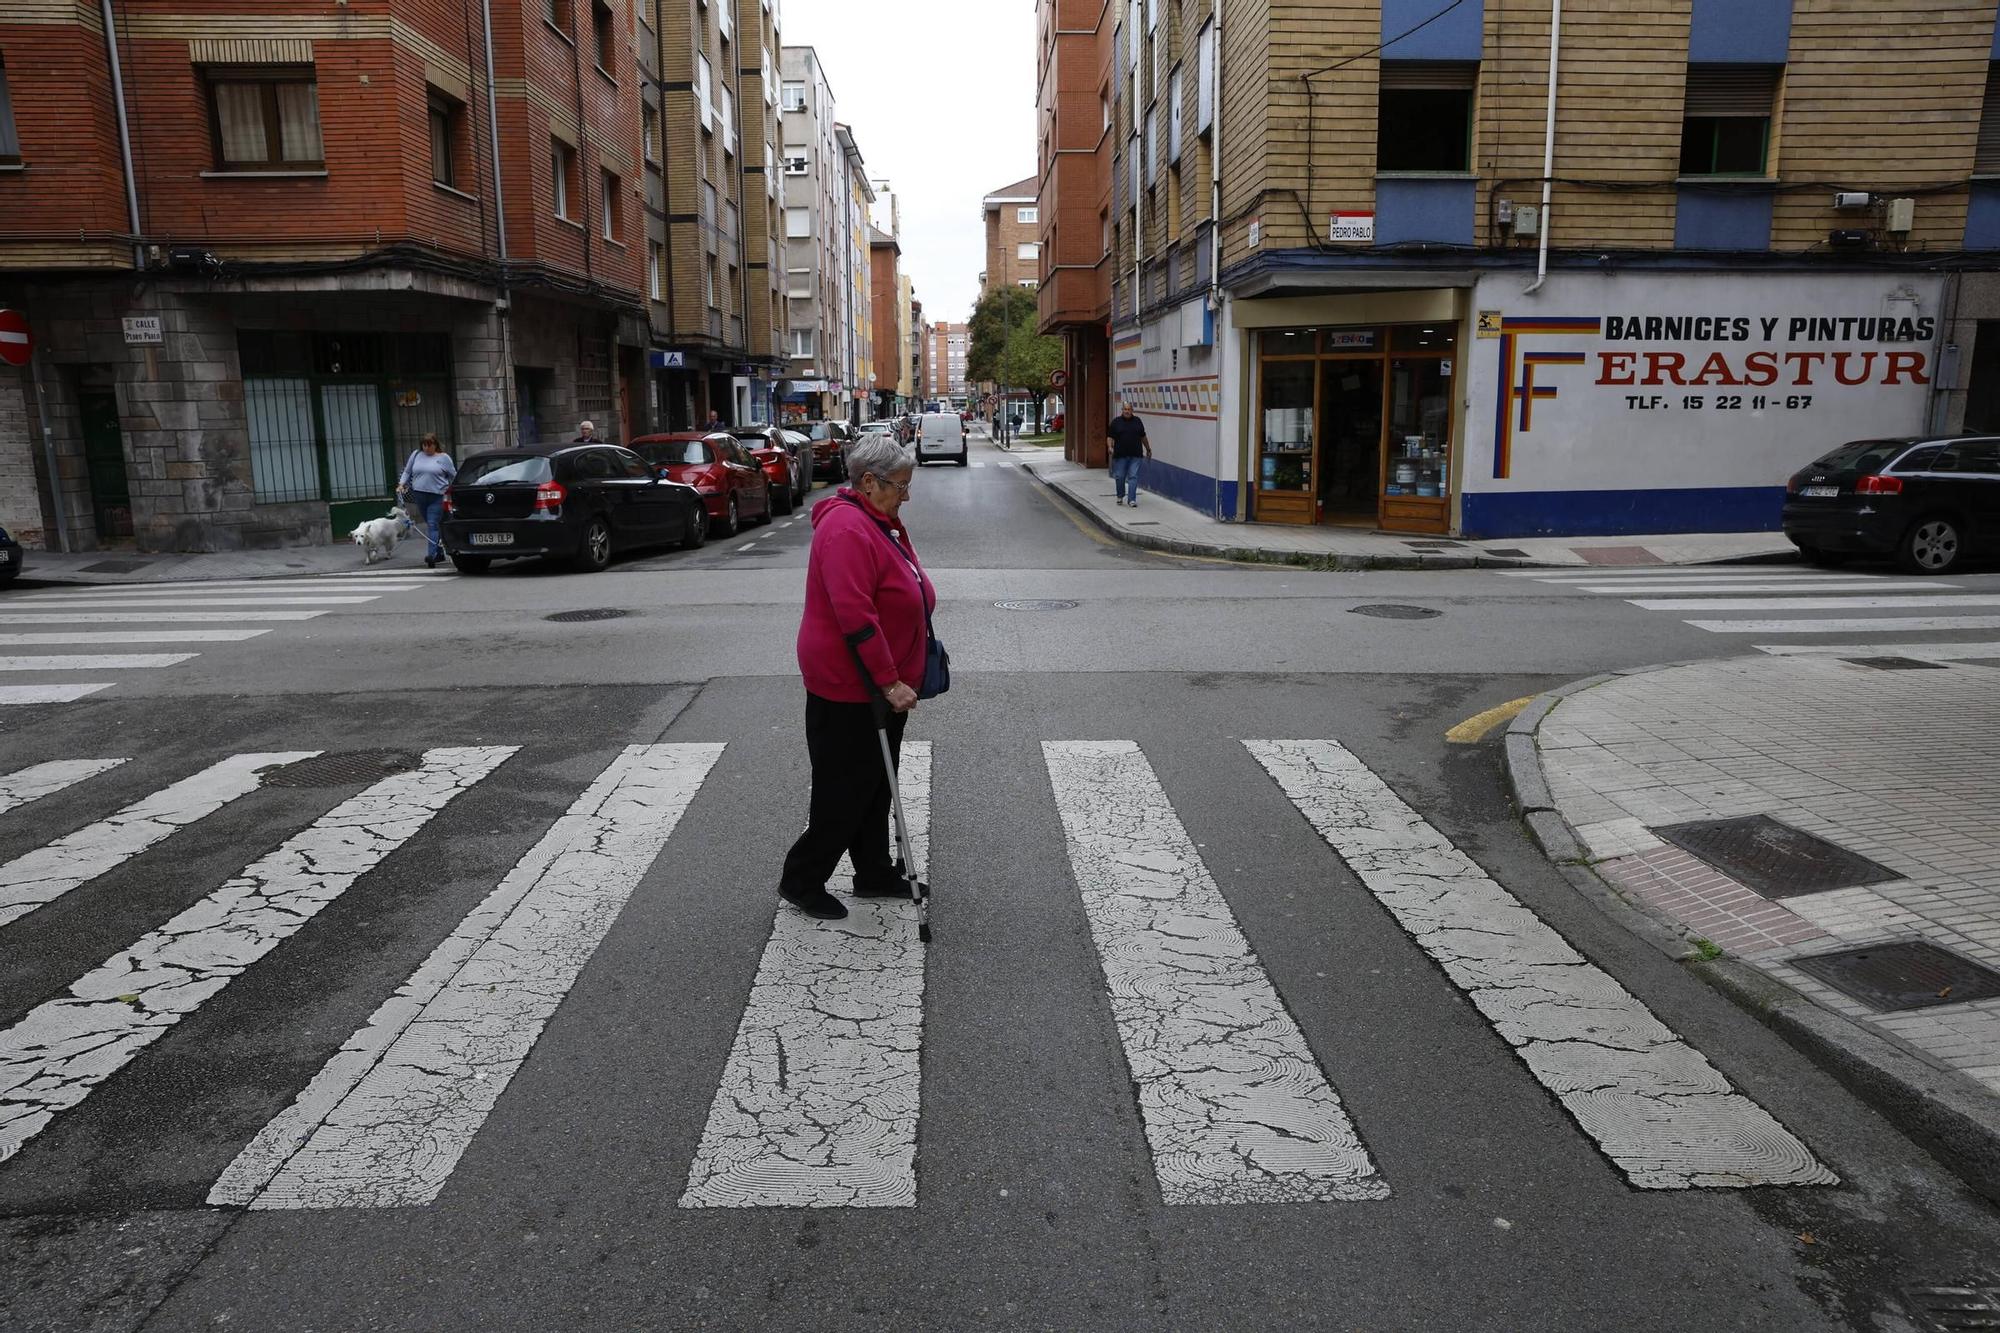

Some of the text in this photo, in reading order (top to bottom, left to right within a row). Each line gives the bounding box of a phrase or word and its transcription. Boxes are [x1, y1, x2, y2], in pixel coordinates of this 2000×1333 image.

[1332, 227, 1371, 238] PEDRO PABLO
[135, 320, 155, 329] CALLE
[1605, 316, 1935, 342] BARNICES Y PINTURAS
[1625, 395, 1669, 410] TLF.
[1682, 395, 1704, 410] 15
[1715, 395, 1742, 410] 22
[474, 534, 494, 543] 1049
